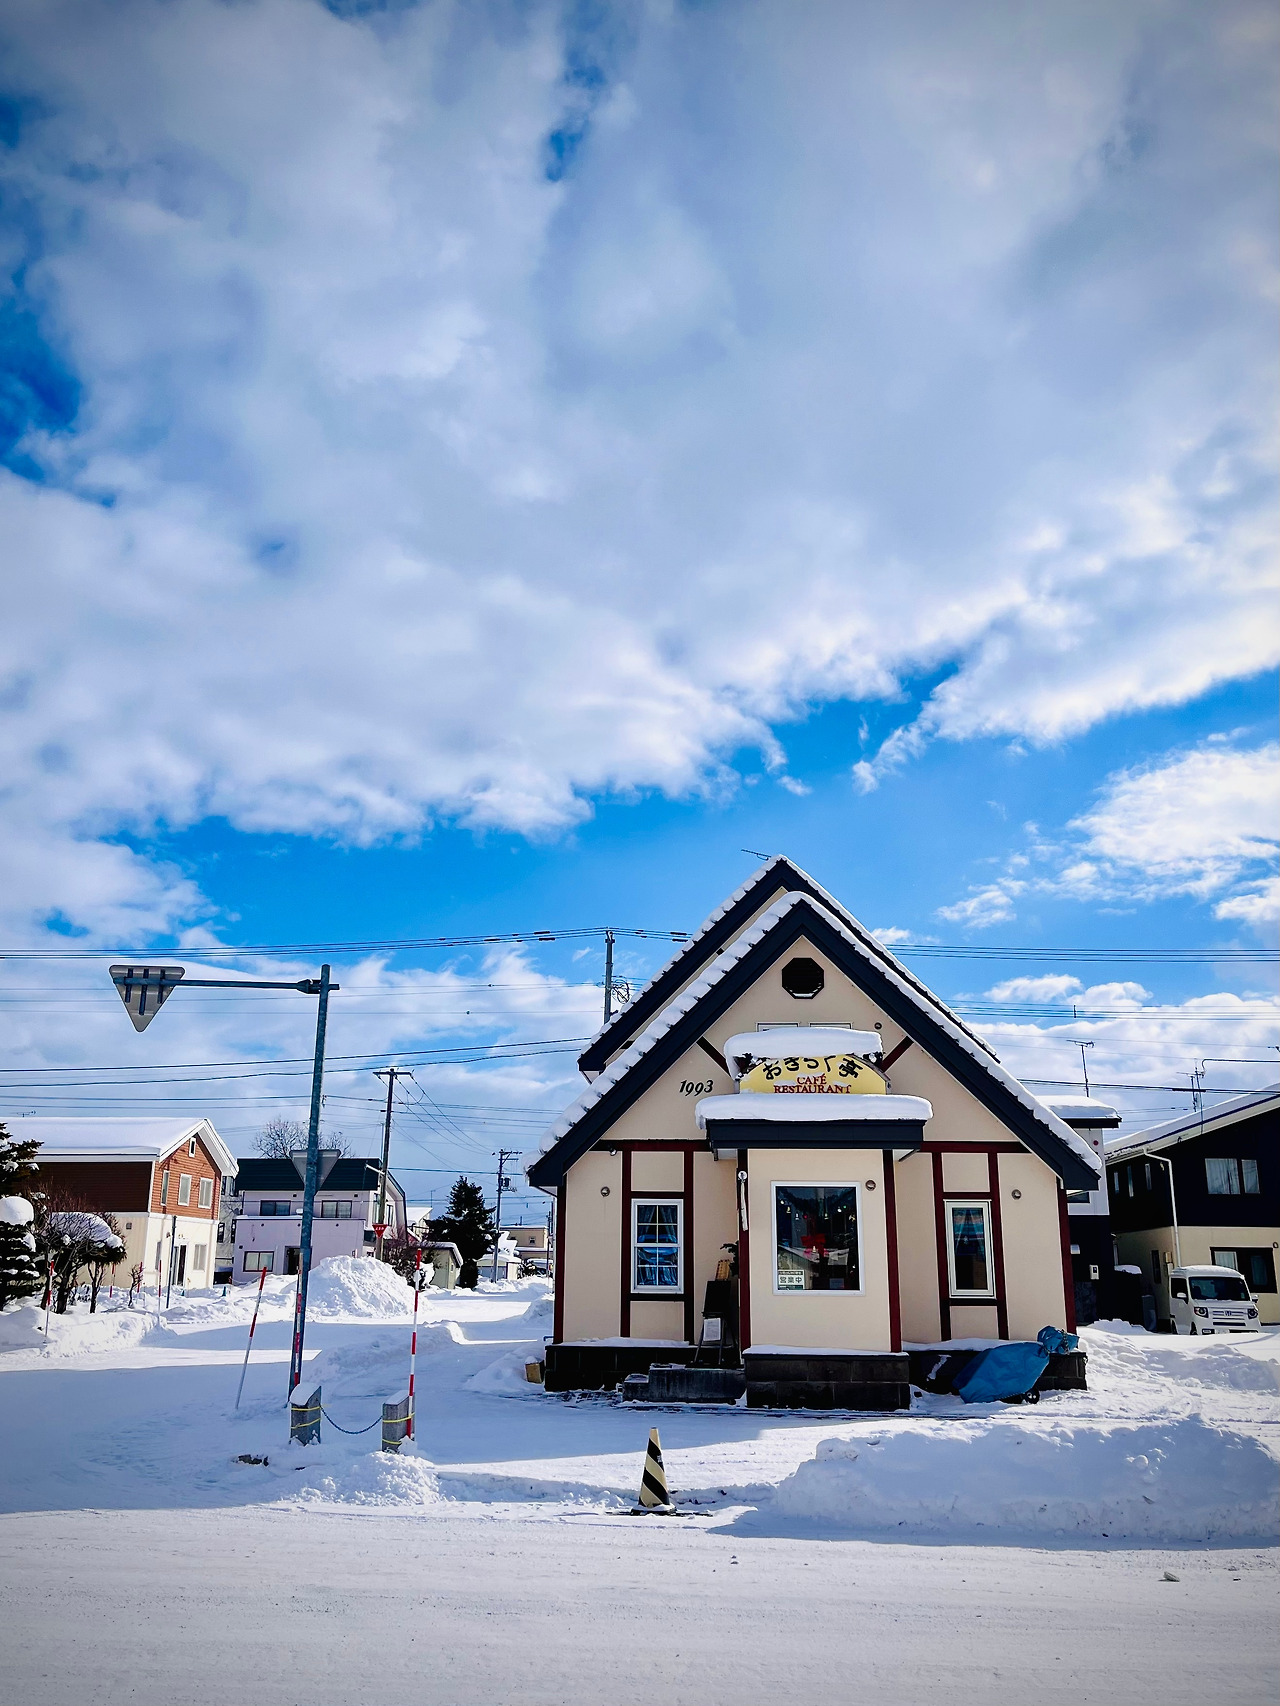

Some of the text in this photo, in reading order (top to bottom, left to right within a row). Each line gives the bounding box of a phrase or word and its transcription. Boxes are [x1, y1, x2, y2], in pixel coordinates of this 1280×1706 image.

[796, 1073, 827, 1085] CAFÉ
[679, 1079, 714, 1097] 1993
[773, 1084, 852, 1094] RESTAURANT
